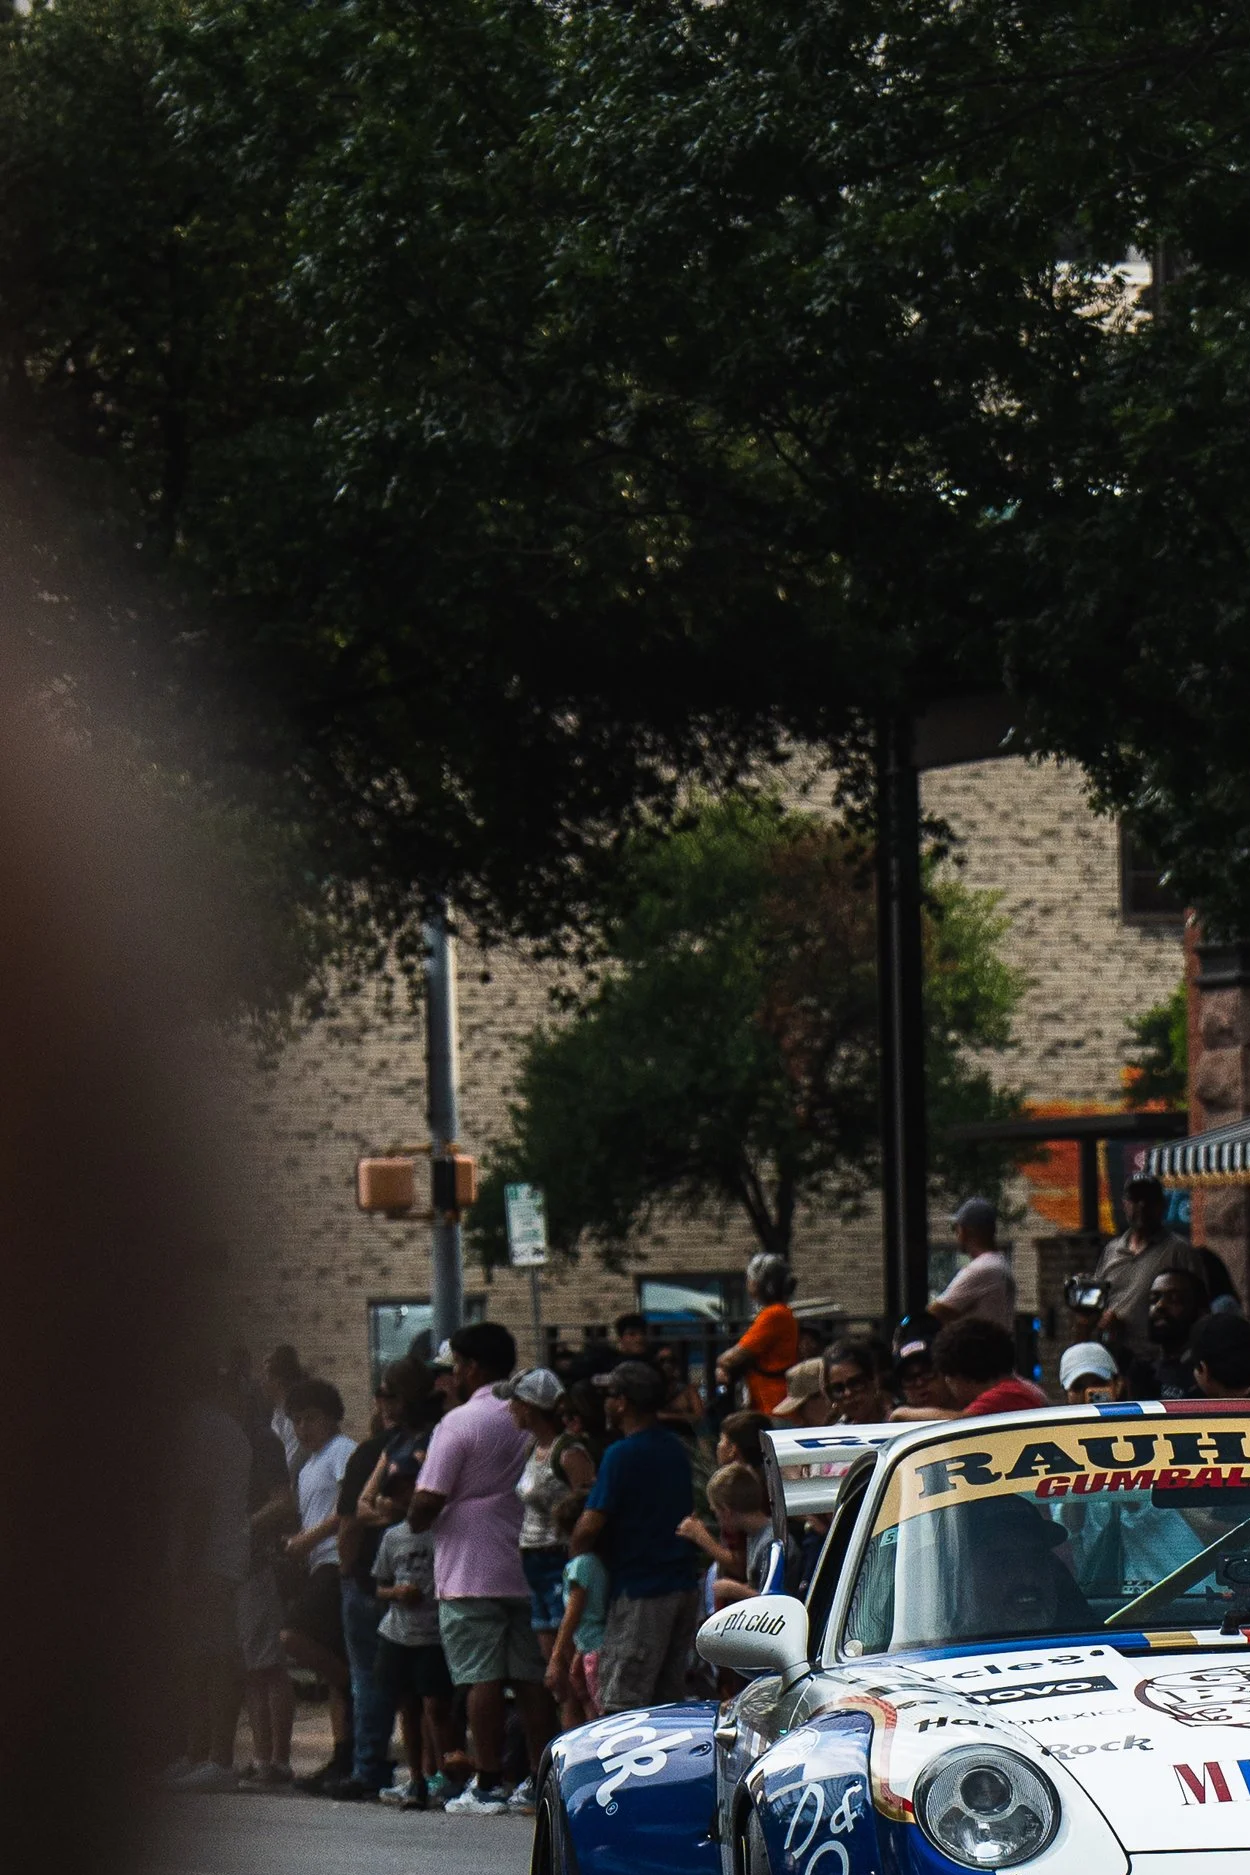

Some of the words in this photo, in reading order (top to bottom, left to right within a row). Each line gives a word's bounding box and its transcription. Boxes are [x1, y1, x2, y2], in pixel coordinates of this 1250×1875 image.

[745, 1611, 786, 1636] club
[913, 1715, 1004, 1733] Har
[998, 1707, 1137, 1727] OMEXICO
